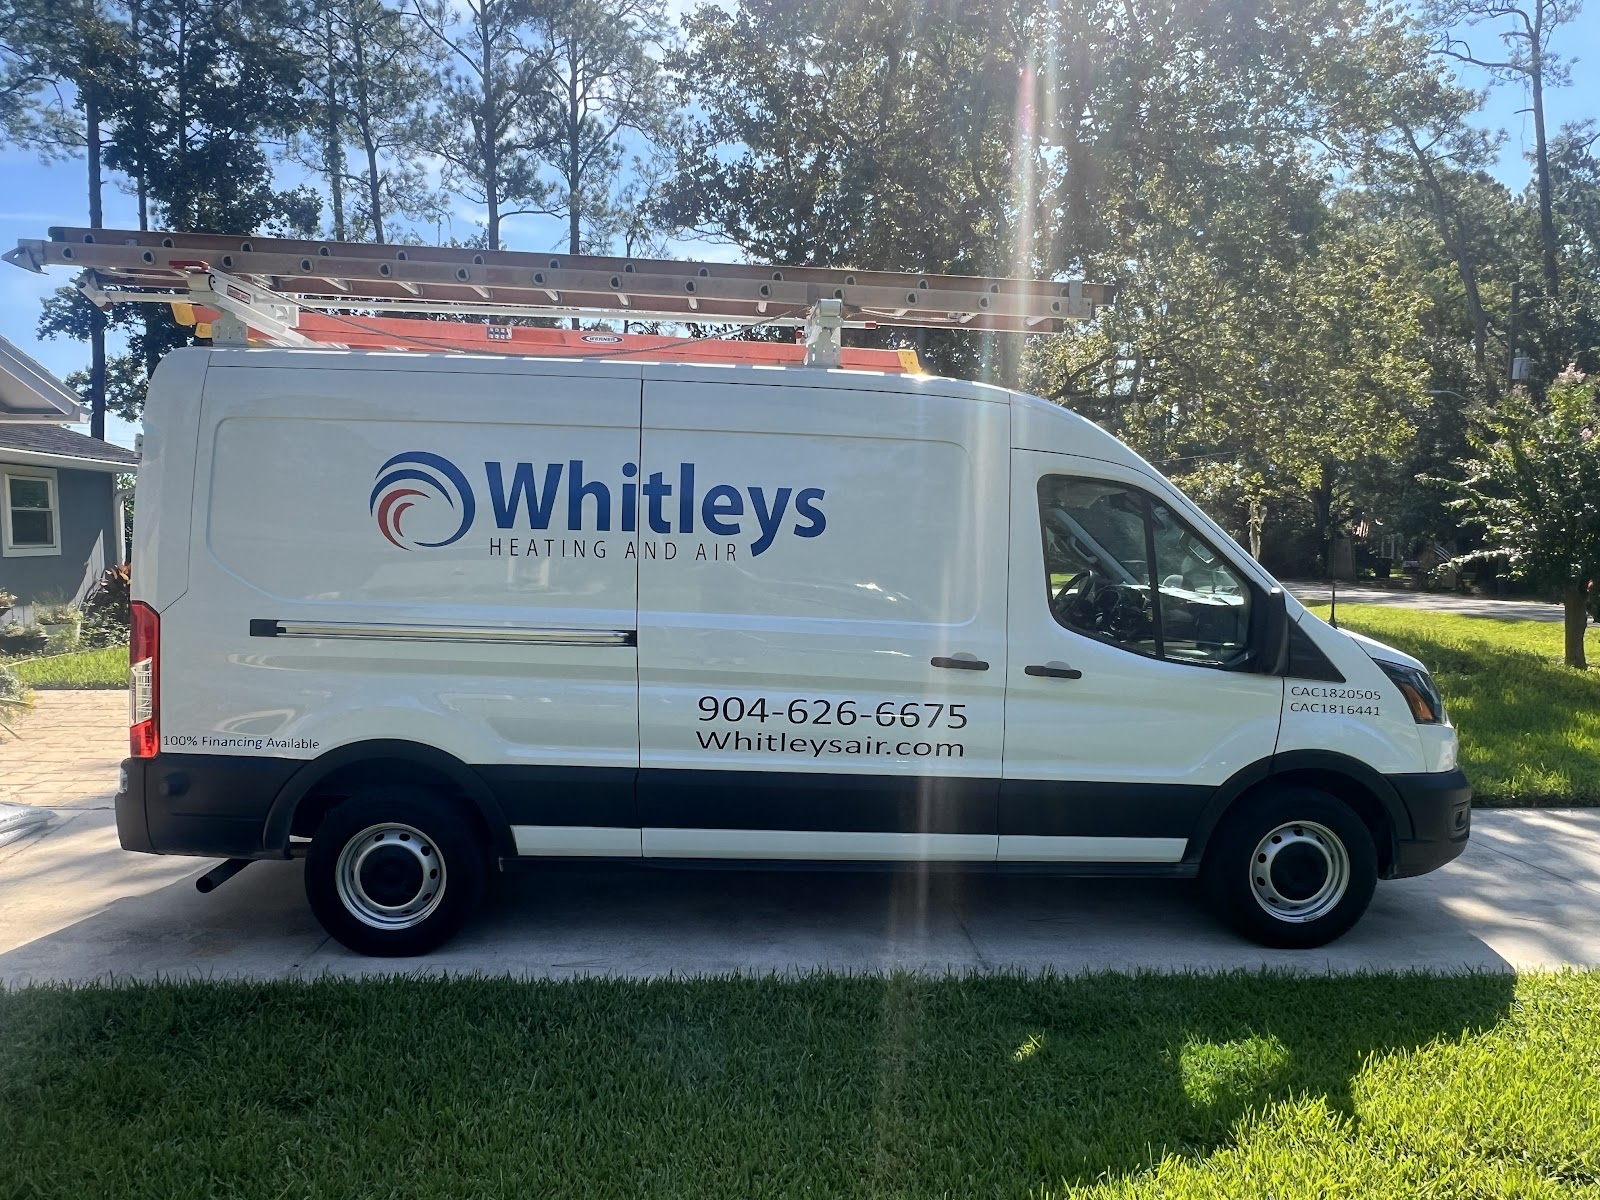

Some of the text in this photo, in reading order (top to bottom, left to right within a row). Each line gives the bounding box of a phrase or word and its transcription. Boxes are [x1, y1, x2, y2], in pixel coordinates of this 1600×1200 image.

[484, 460, 827, 557] Whitleys
[490, 538, 737, 561] HEATING AND AIR
[1291, 686, 1381, 700] CAC1820505
[698, 696, 967, 729] 904-626-6675
[1290, 702, 1381, 716] CAC1816441
[163, 735, 320, 749] 100% Financing Available
[696, 731, 964, 757] Whitleysair.com
